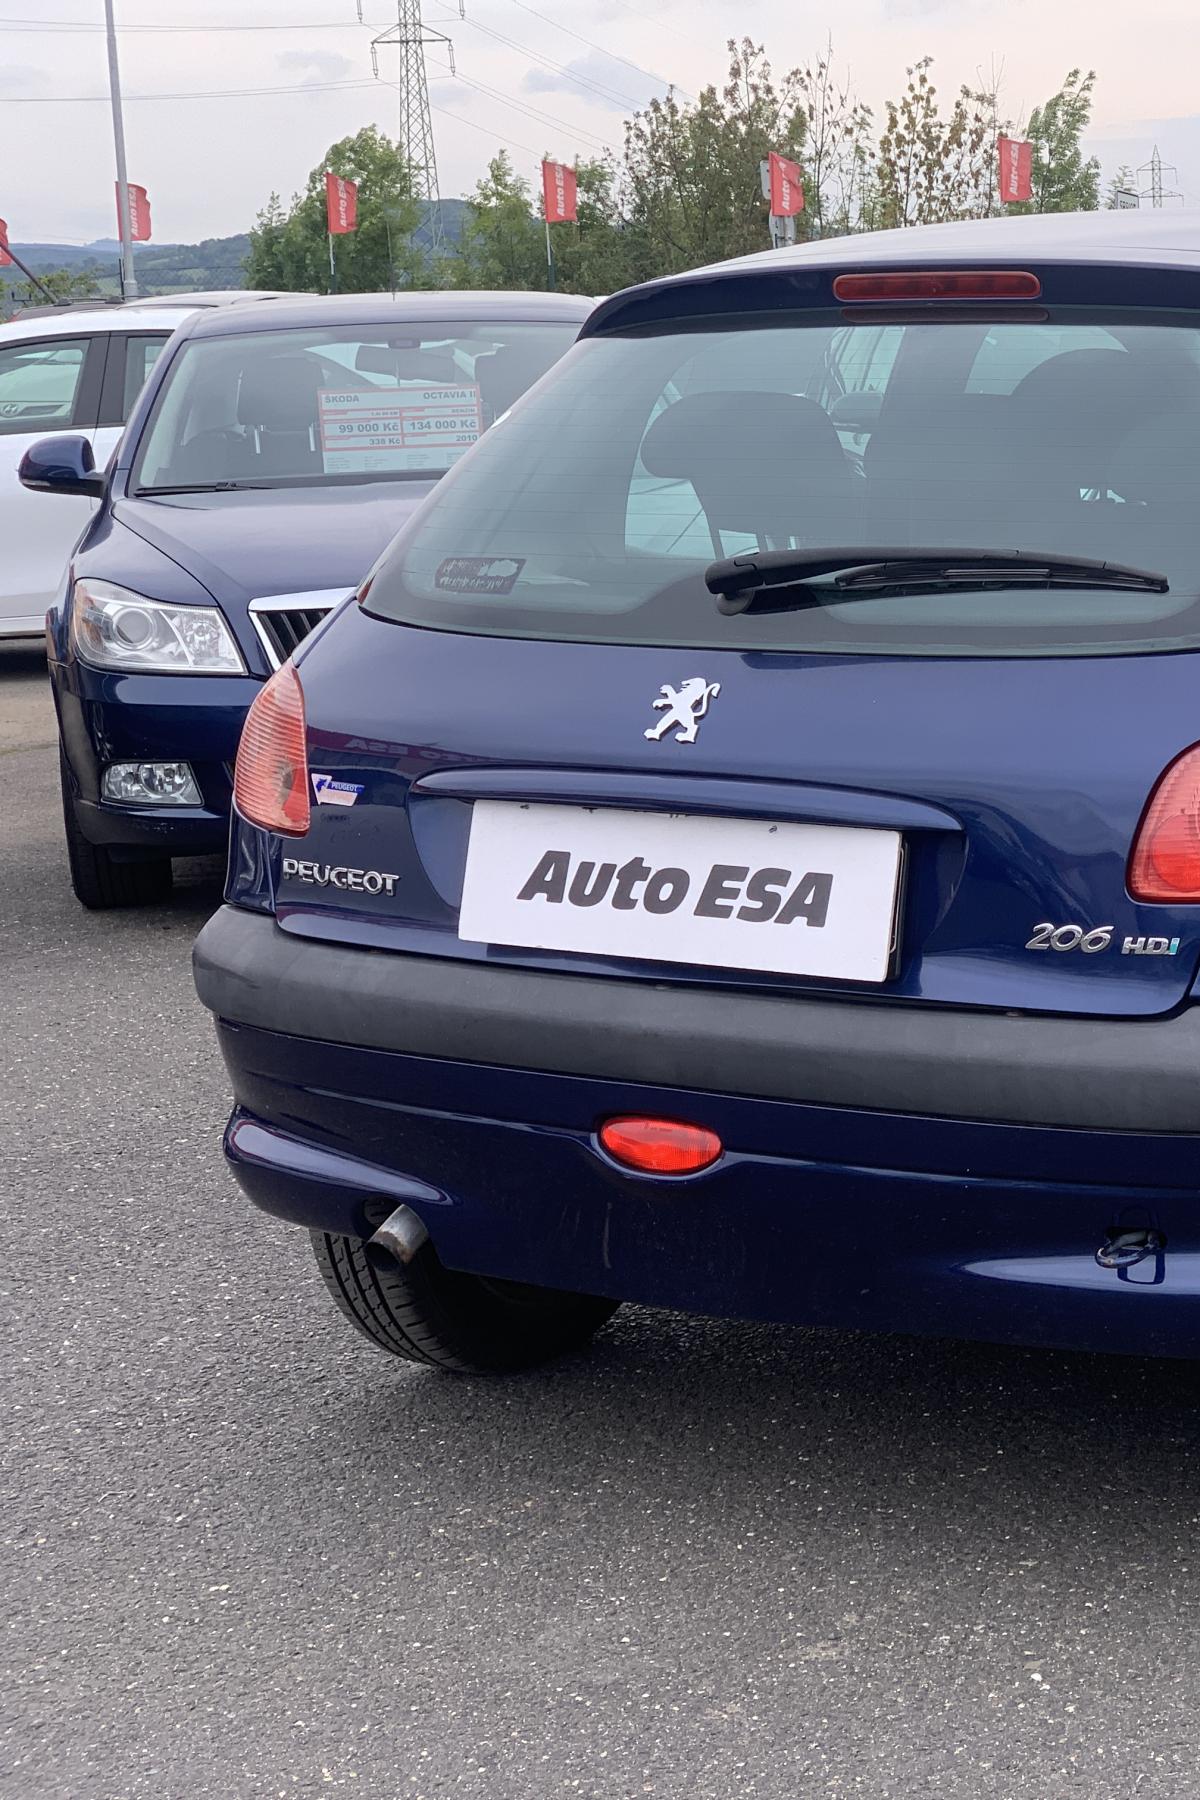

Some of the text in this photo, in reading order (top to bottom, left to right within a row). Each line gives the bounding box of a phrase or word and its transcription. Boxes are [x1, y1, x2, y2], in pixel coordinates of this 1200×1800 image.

[557, 187, 565, 216] Auto
[782, 180, 790, 210] Auto
[339, 200, 347, 227] Auto
[423, 391, 467, 399] OCTAVIA
[338, 421, 399, 433] 99 000 Kč
[410, 419, 477, 430] 134 000 Kč
[331, 781, 358, 792] PEUGEOT
[283, 858, 399, 896] PEUGEOT
[517, 850, 833, 928] Auto ESA
[1025, 922, 1115, 954] 206
